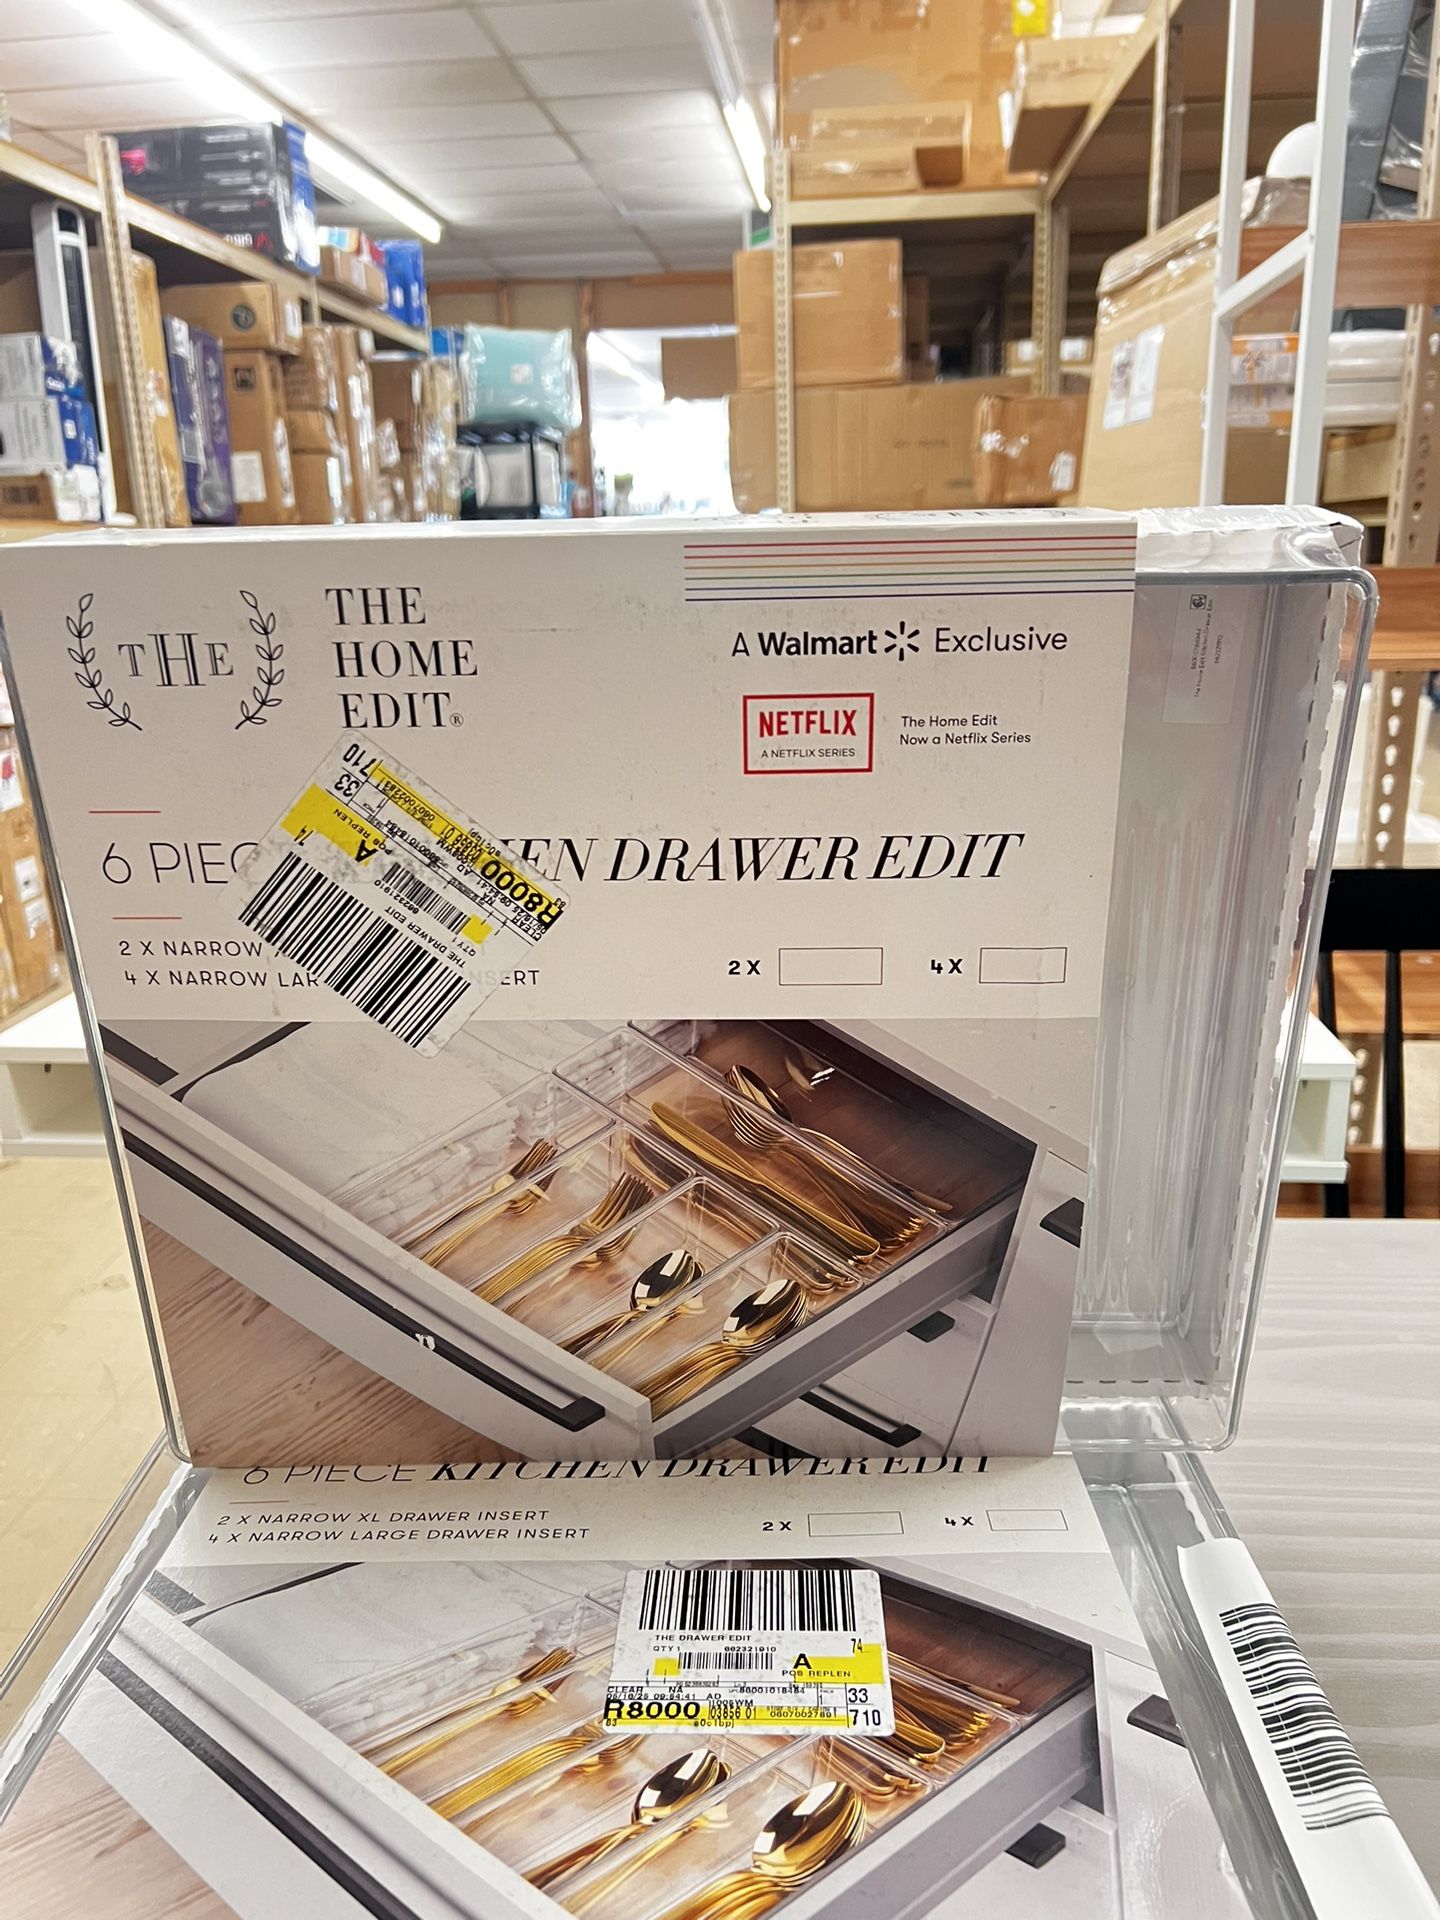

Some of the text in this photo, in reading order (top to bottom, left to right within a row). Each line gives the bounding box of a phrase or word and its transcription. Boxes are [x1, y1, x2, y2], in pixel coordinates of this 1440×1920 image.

[325, 587, 425, 625] THE
[732, 626, 1067, 656] A Walmart Exclusive
[118, 633, 233, 686] THE
[332, 640, 477, 677] HOME
[760, 710, 857, 737] NETFLIX
[901, 715, 997, 727] The Home Edit
[900, 734, 928, 745] Now
[945, 733, 987, 744] Netflix
[991, 732, 1031, 743] Series
[341, 742, 378, 777] 710
[771, 749, 815, 757] NETFLIX
[819, 748, 855, 757] SERIES
[333, 771, 361, 799] 33
[332, 807, 371, 839] REPLEN
[293, 824, 313, 846] 74
[103, 843, 131, 884] 6
[150, 843, 259, 883] PIEC
[603, 836, 860, 883] DRAWER
[866, 832, 1026, 880] EDIT
[349, 838, 378, 867] A
[456, 863, 471, 877] AD
[476, 856, 563, 928] R8000
[481, 891, 496, 904] NA
[511, 915, 542, 940] CLEAR
[384, 904, 466, 968] THE DRAWER EDIT
[119, 941, 131, 955] 2
[140, 941, 154, 955] X
[163, 941, 262, 957] NARROW
[457, 940, 476, 956] QTY
[728, 960, 760, 975] 2 X
[931, 959, 963, 974] 4 X
[125, 971, 136, 985] 4
[146, 970, 160, 985] X
[169, 971, 267, 986] NARROW
[279, 972, 318, 987] LAR
[429, 1461, 654, 1481] KITCHEN
[657, 1457, 870, 1477] DRAWER
[217, 1511, 549, 1525] 2 X NARROW XL DRAWER INSERT
[763, 1521, 791, 1531] 2 X
[945, 1517, 974, 1526] 4 X
[209, 1529, 589, 1543] 4 X NARROW LARGE DRAWER INSERT
[852, 1639, 862, 1653] 74
[794, 1654, 812, 1669] A
[848, 1688, 868, 1702] 33
[604, 1700, 700, 1719] R8000
[849, 1710, 881, 1725] 710
